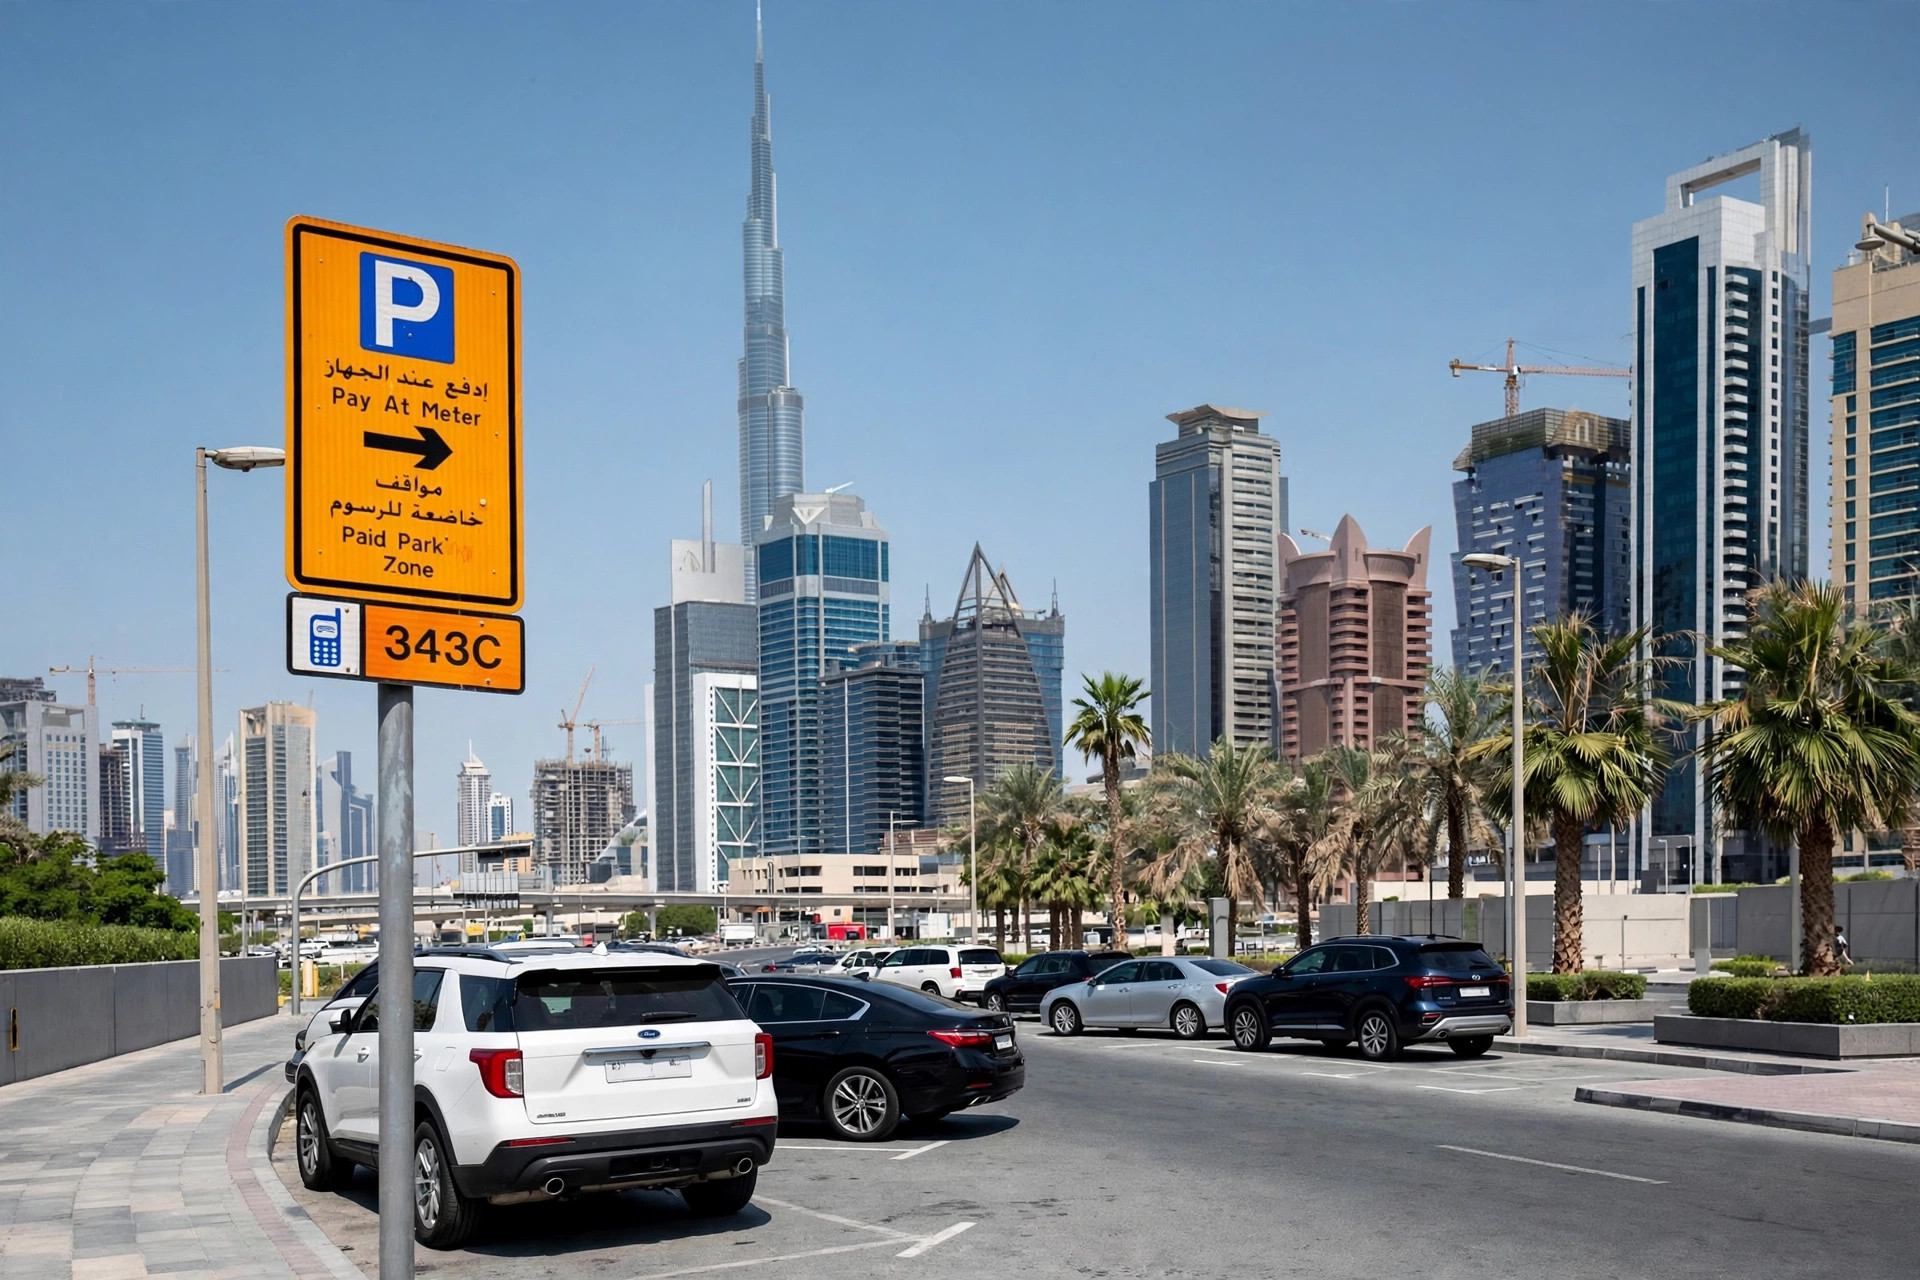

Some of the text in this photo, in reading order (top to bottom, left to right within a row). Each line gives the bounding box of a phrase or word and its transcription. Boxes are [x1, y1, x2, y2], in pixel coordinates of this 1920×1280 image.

[375, 260, 440, 347] P
[324, 358, 389, 381] الجهاز
[397, 371, 434, 389] عند
[333, 387, 481, 426] Pay At Meter
[376, 475, 442, 497] مواقف
[330, 500, 483, 526] خاضعة للرسوم
[342, 526, 386, 548] Paid
[383, 556, 434, 578] Zone
[384, 625, 502, 669] 343C
